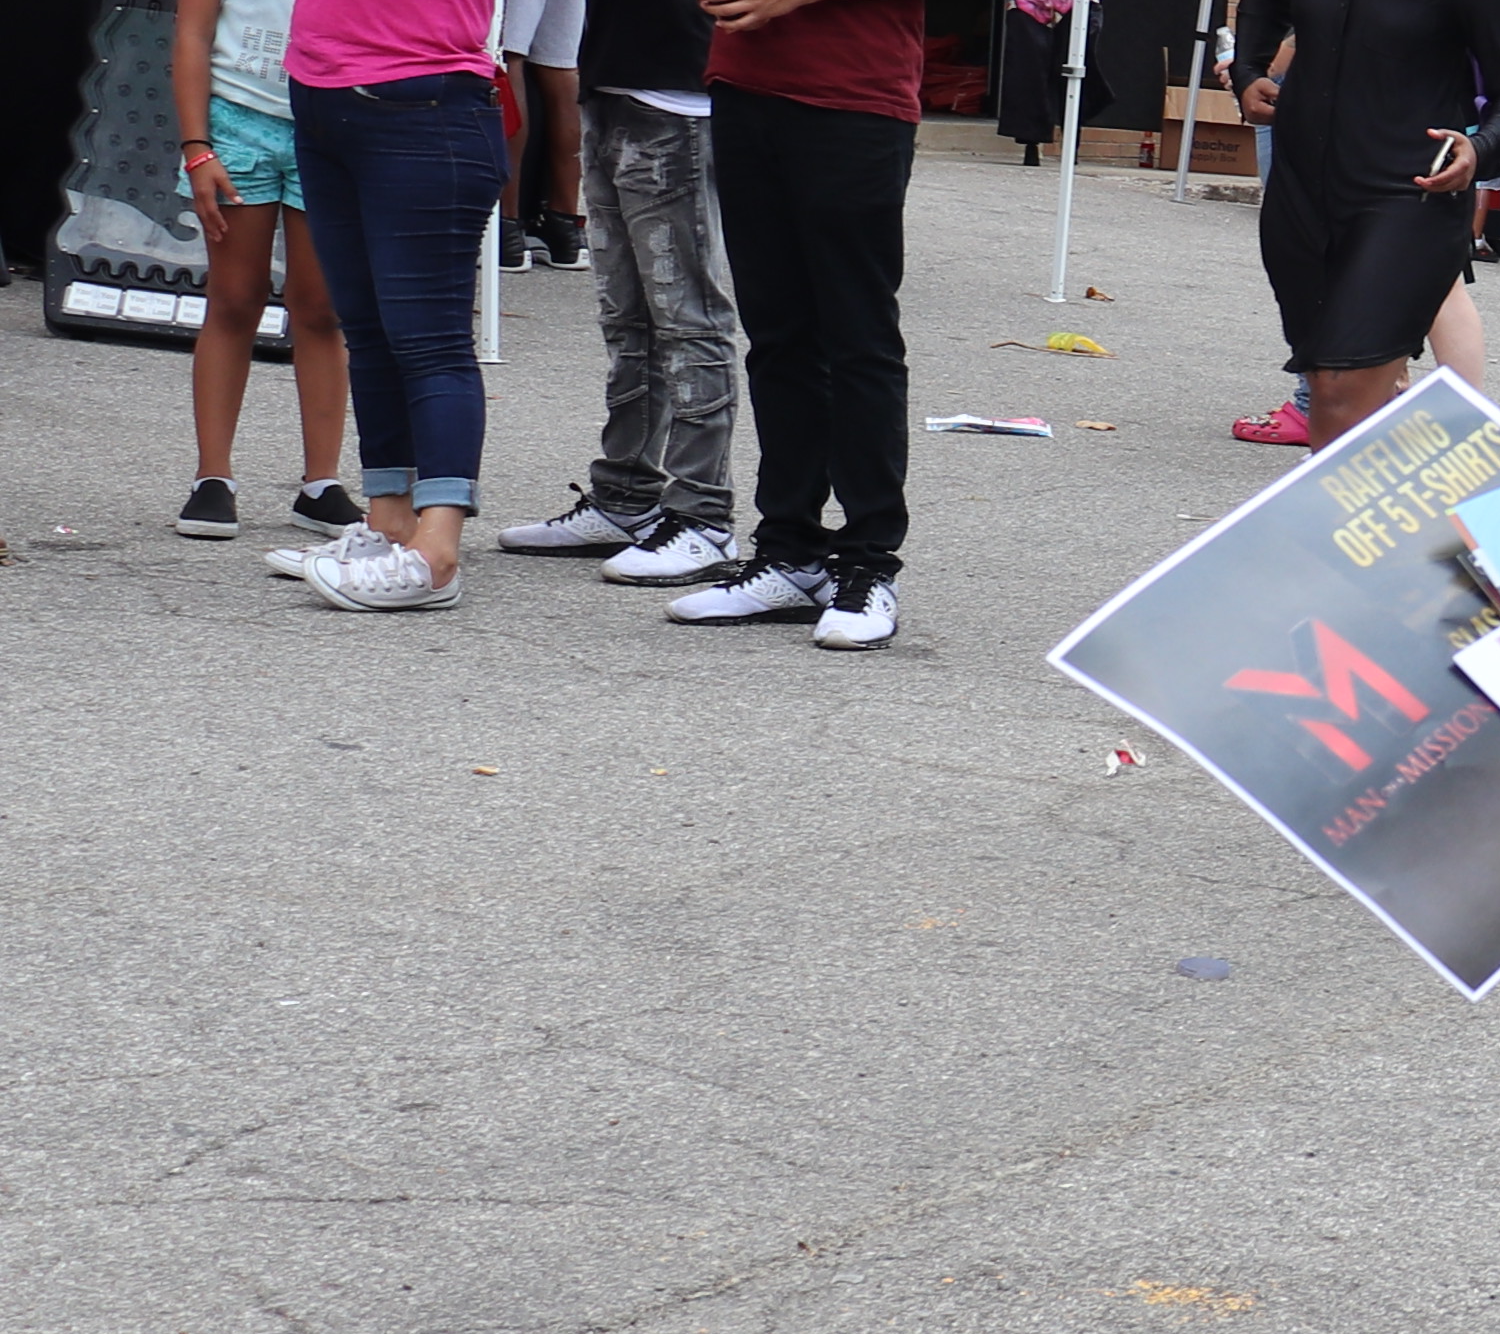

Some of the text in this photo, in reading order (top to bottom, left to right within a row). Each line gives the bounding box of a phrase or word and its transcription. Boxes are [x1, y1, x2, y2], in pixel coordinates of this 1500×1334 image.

[1319, 410, 1451, 514] RAFFLING
[1333, 508, 1397, 568] OFF
[1378, 495, 1420, 534] 5
[1322, 786, 1387, 847] MAN
[1394, 694, 1500, 785] MISSION
